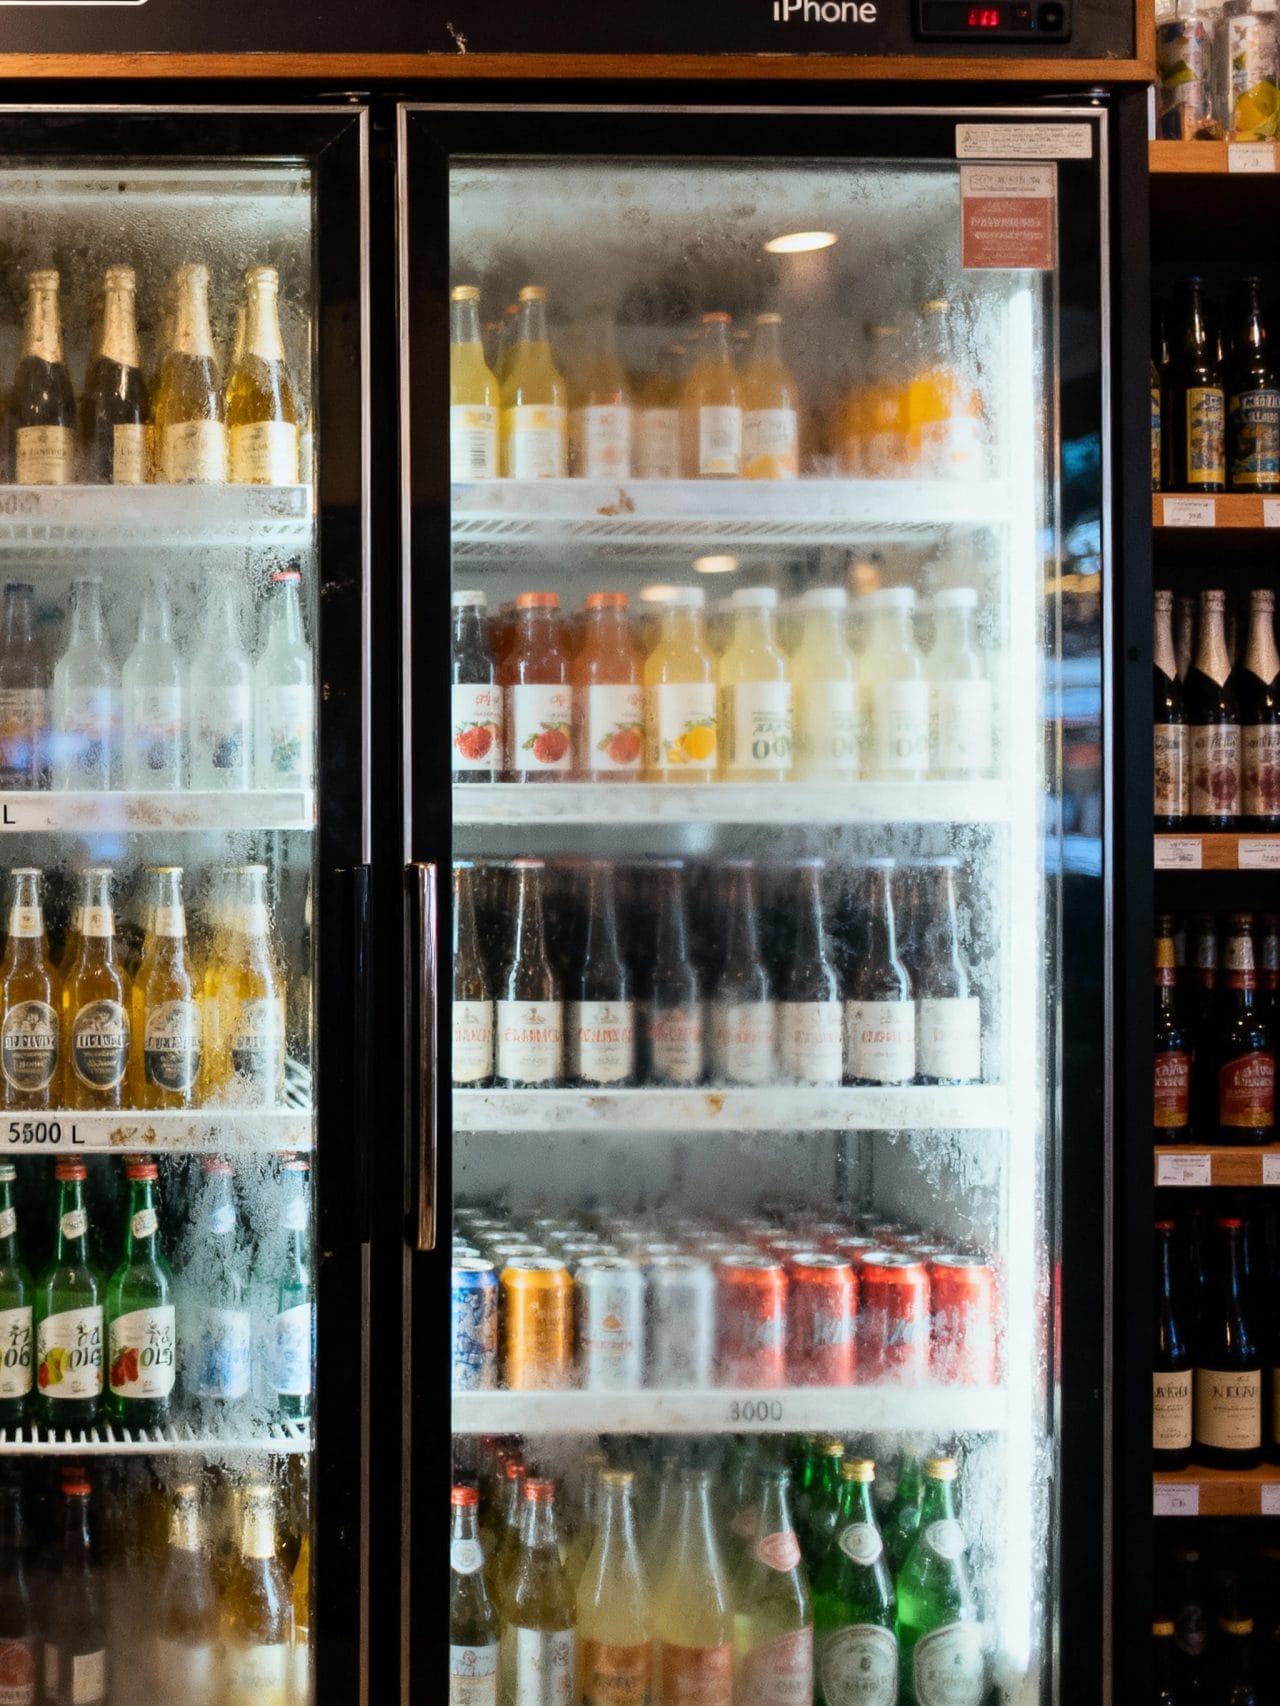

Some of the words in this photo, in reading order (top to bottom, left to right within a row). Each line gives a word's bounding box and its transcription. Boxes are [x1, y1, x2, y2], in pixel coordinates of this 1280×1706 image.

[773, 0, 877, 23] iPhone
[3, 804, 16, 824] L
[72, 1125, 85, 1144] L
